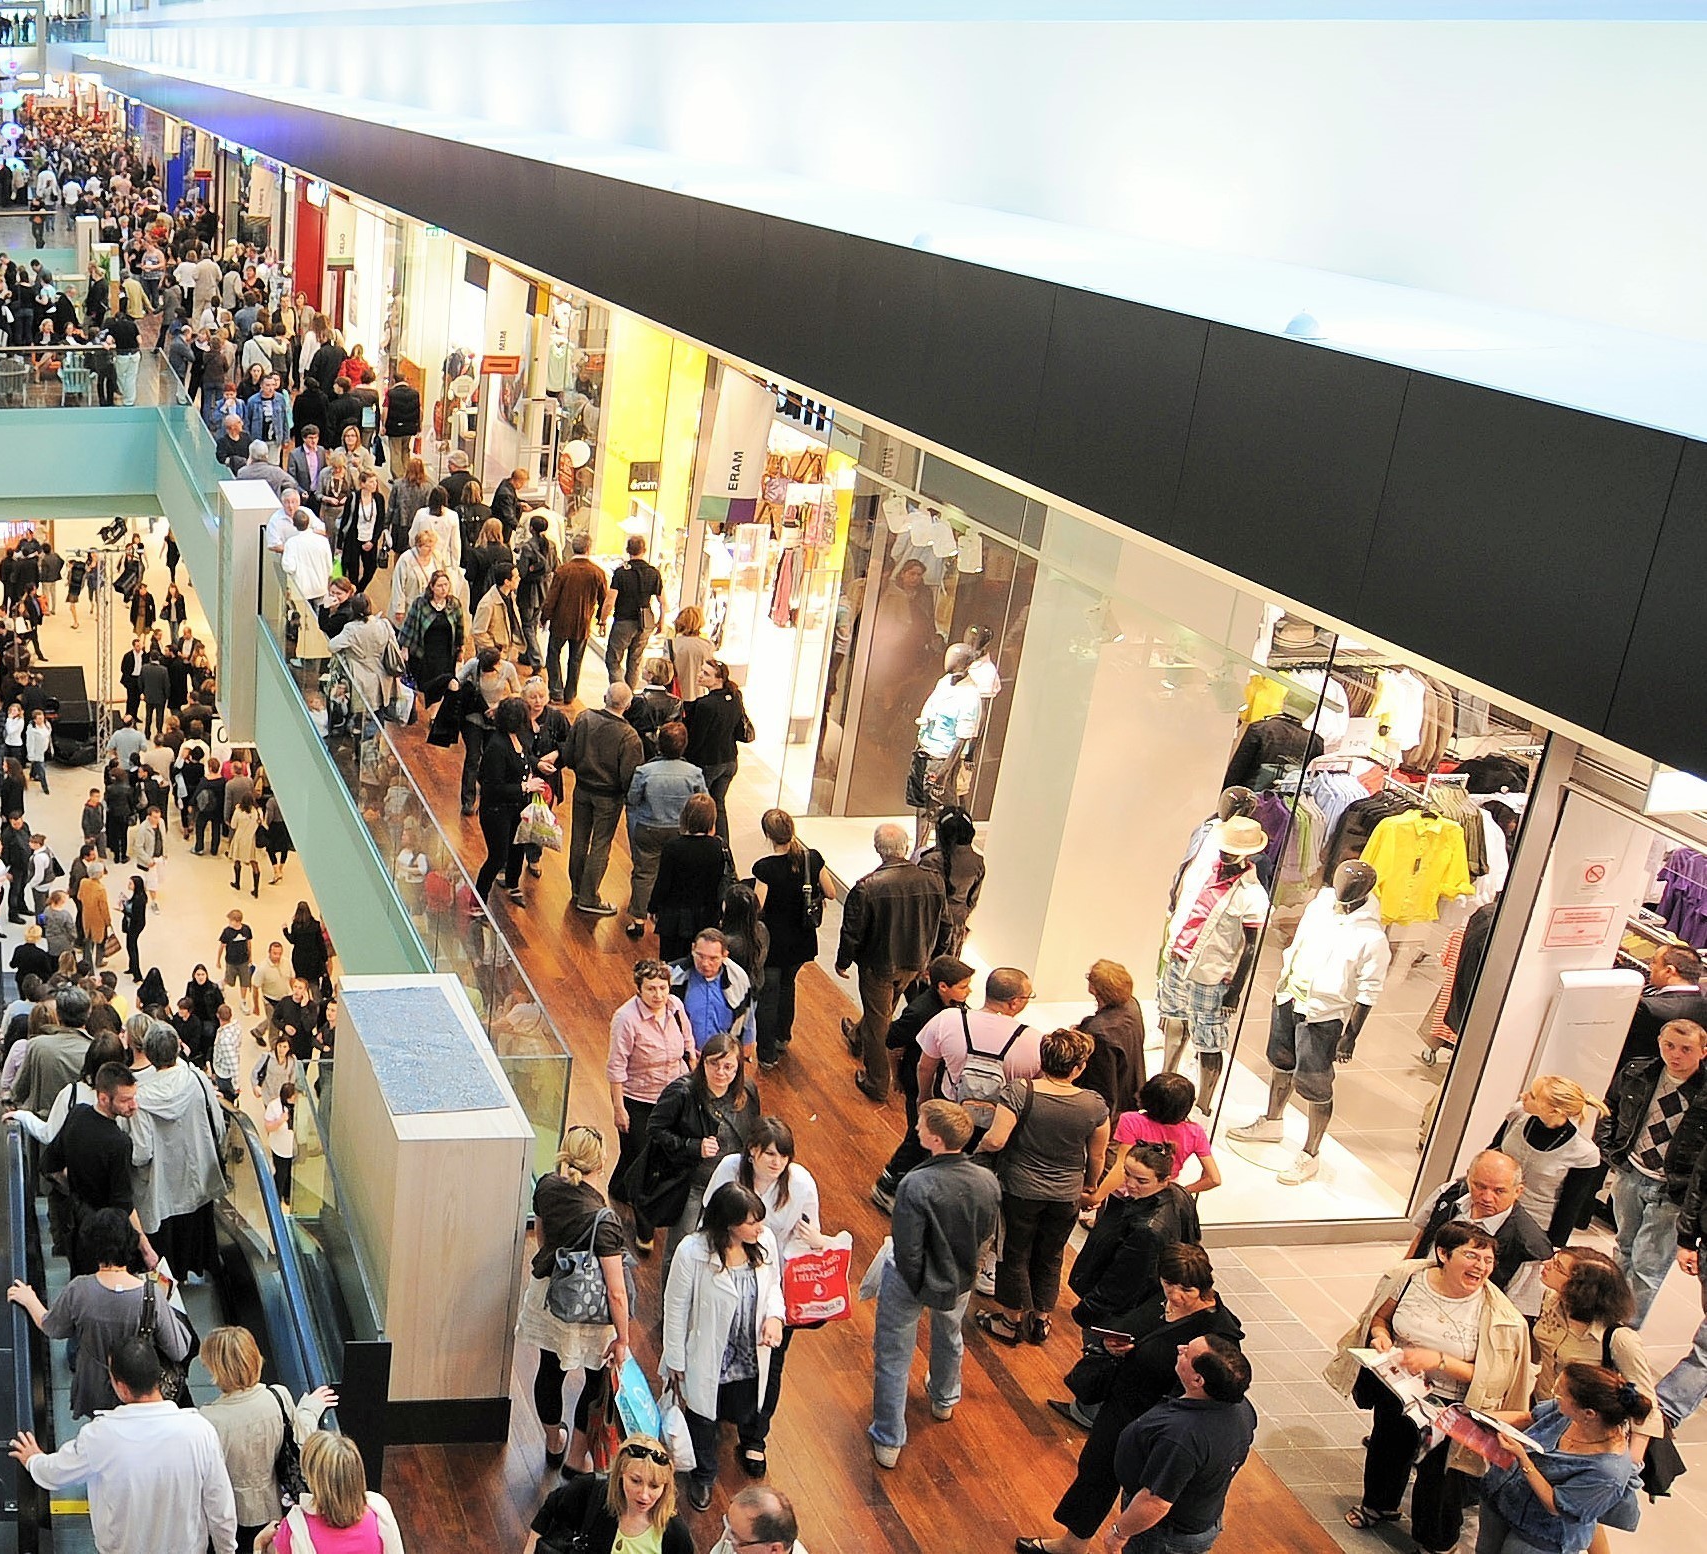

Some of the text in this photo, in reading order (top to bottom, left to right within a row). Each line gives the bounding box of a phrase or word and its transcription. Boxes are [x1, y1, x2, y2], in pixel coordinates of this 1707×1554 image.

[498, 331, 507, 350] MIM
[727, 451, 744, 490] ERAM
[630, 479, 658, 490] éram
